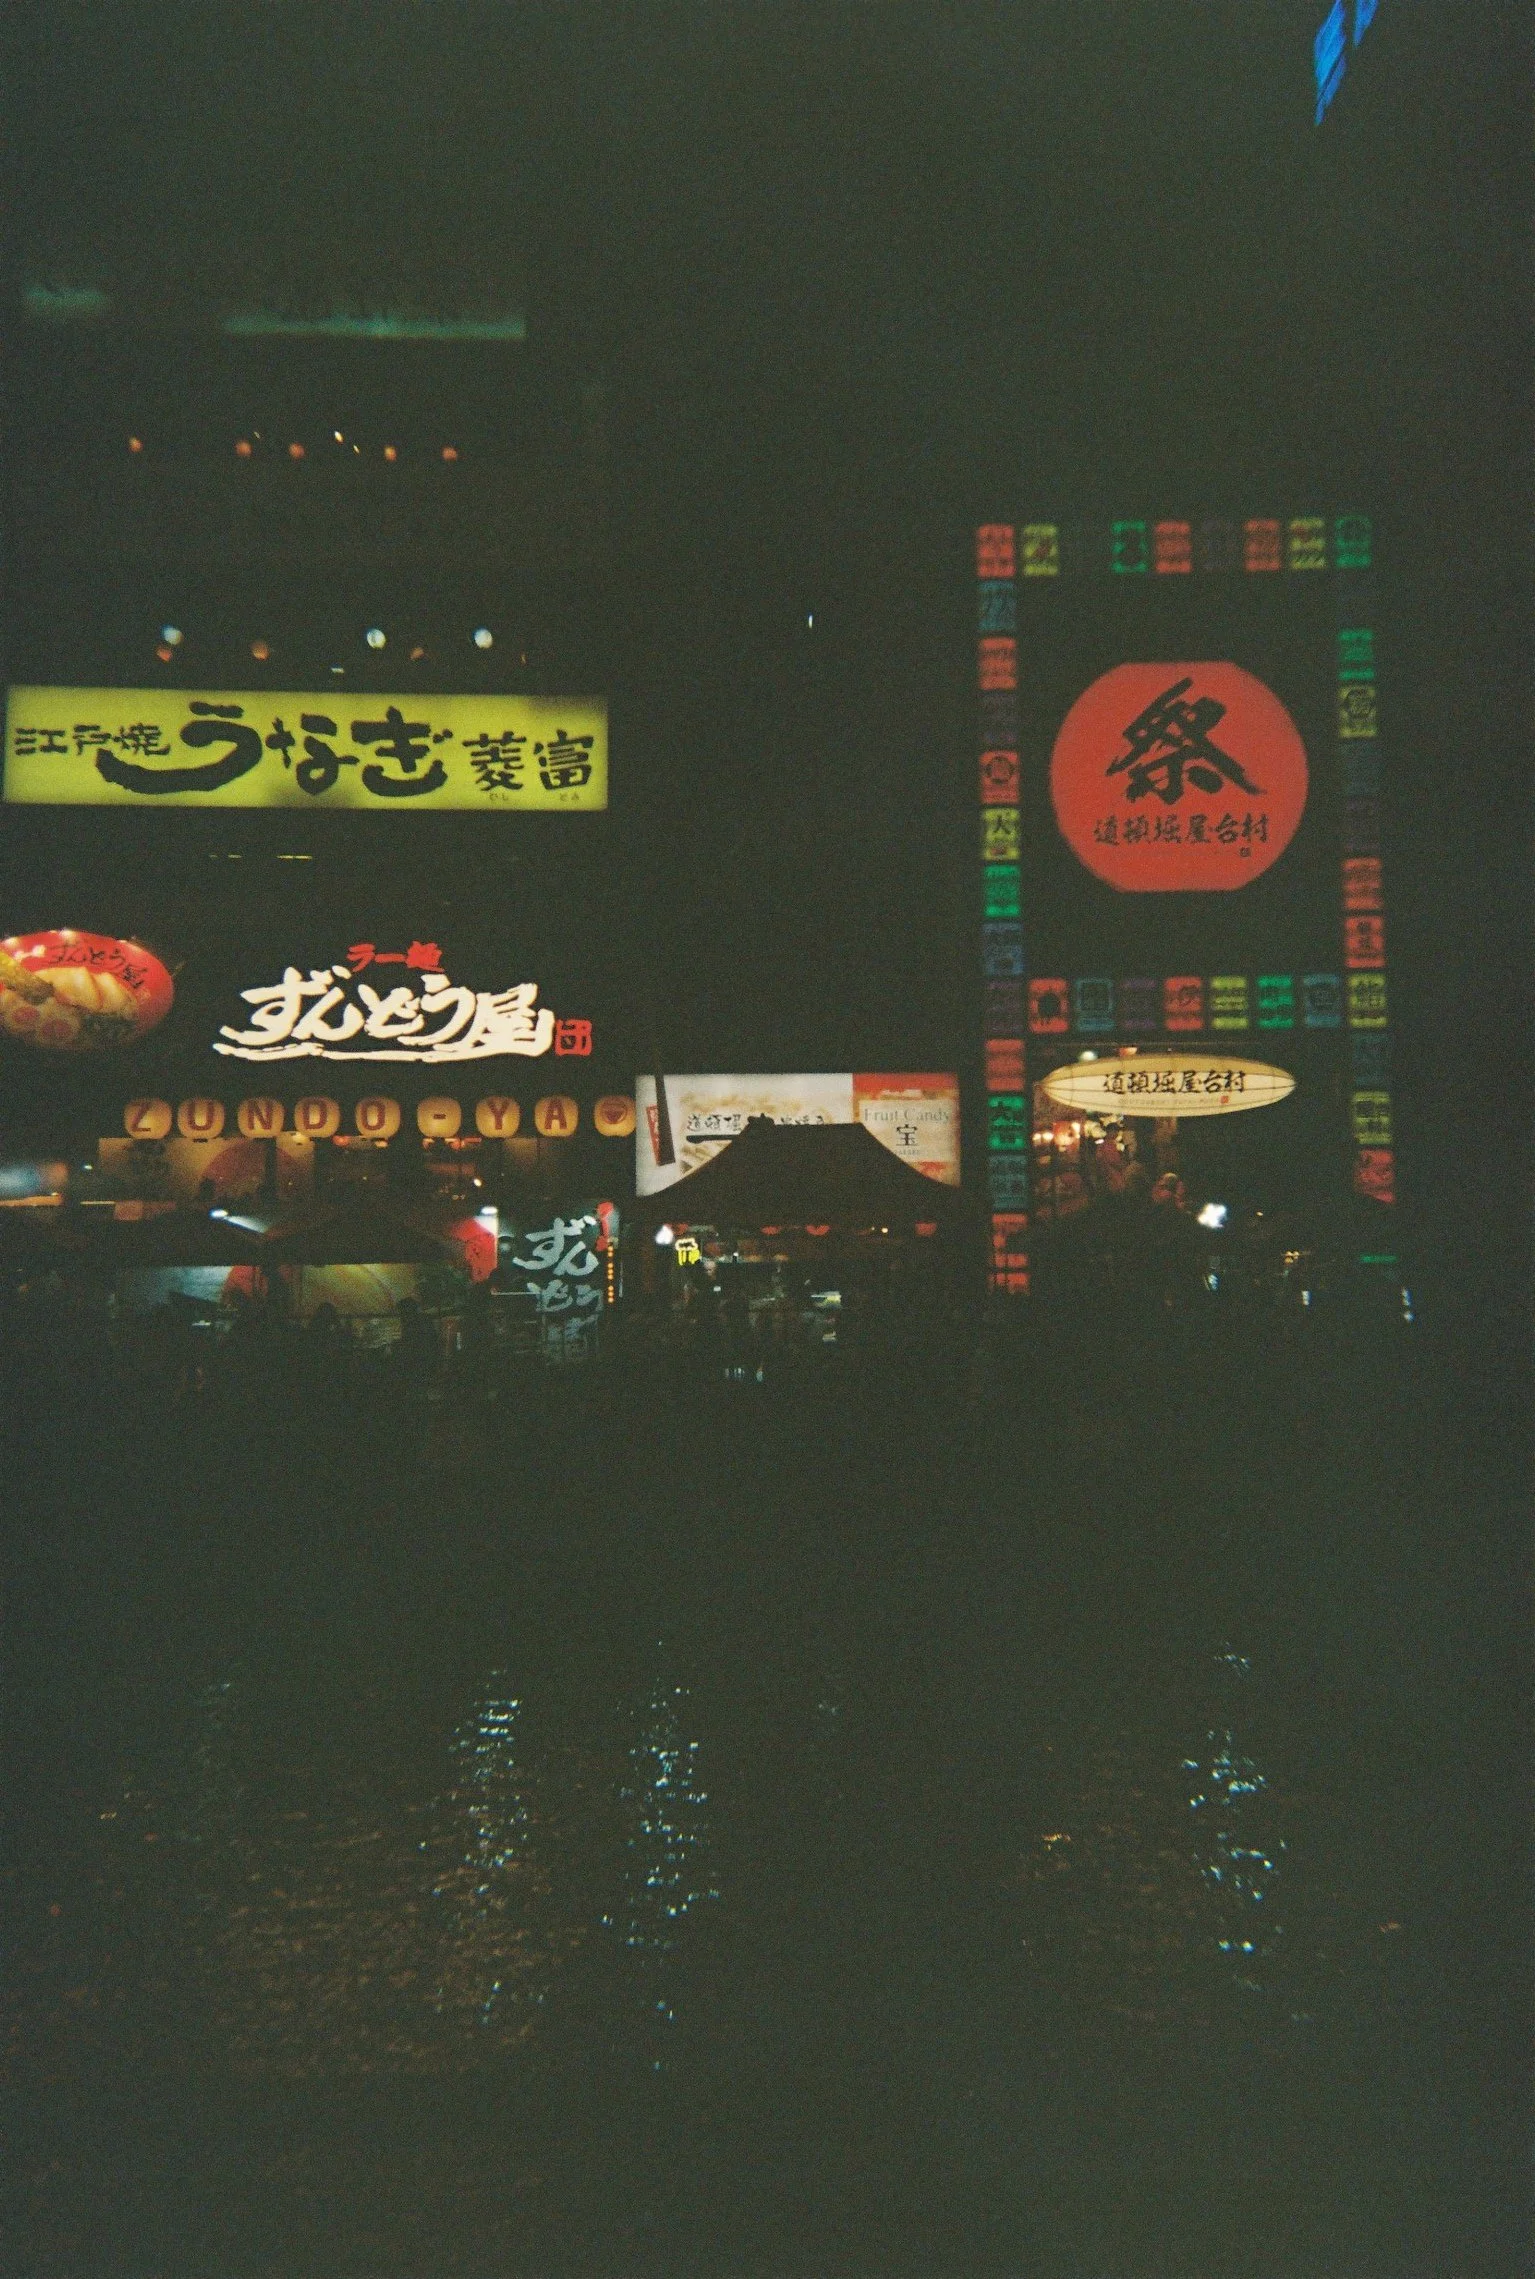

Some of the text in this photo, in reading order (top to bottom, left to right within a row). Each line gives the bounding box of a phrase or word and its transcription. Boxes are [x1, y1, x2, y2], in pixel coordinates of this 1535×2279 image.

[95, 701, 453, 797] うなぎ
[1104, 677, 1266, 805] 祭
[1093, 812, 1269, 847] 道頓堀屋台村
[213, 966, 555, 1061] ずんどう屋
[1103, 1069, 1246, 1095] 道頓堀屋台村
[864, 1108, 949, 1124] Fruit Candy
